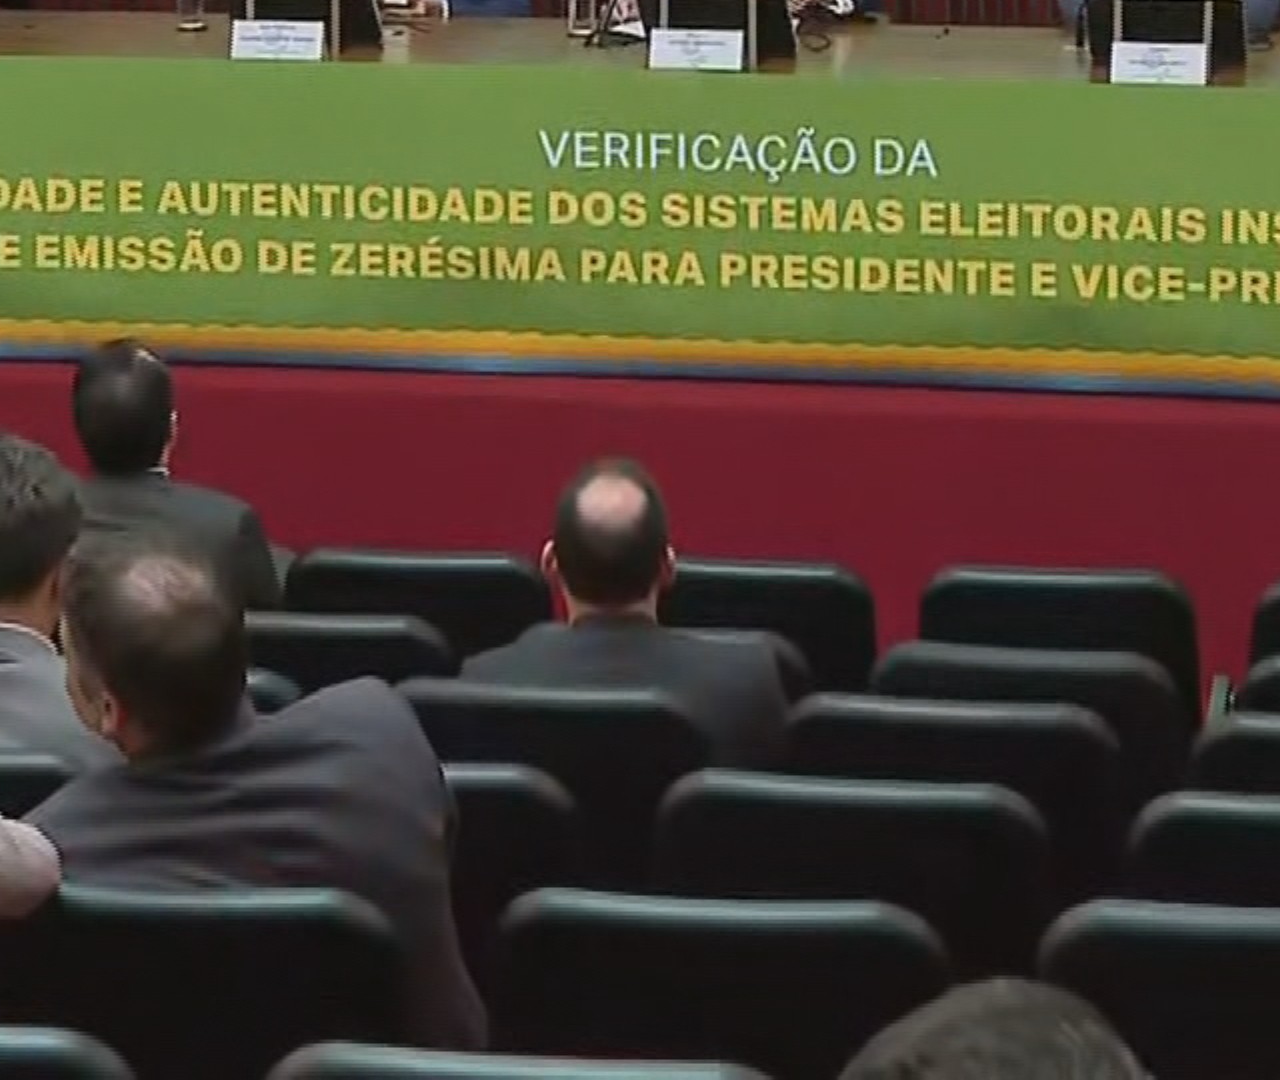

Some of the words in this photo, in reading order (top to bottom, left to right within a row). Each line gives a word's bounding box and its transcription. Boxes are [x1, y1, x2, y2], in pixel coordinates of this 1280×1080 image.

[540, 128, 857, 182] VERIFICAÇÃO
[873, 138, 938, 177] DA
[119, 179, 144, 214] E
[156, 179, 533, 224] AUTENTICIDADE
[548, 189, 648, 227] DOS
[661, 193, 905, 236] SISTEMAS
[920, 200, 1207, 243] ELEITORAIS
[35, 228, 243, 273] EMISSÃO
[258, 239, 316, 275] DE
[329, 235, 566, 282] ZERÉSIMA
[580, 248, 706, 287] PARA
[720, 254, 1016, 298] PRESIDENTE
[1032, 262, 1058, 297] E
